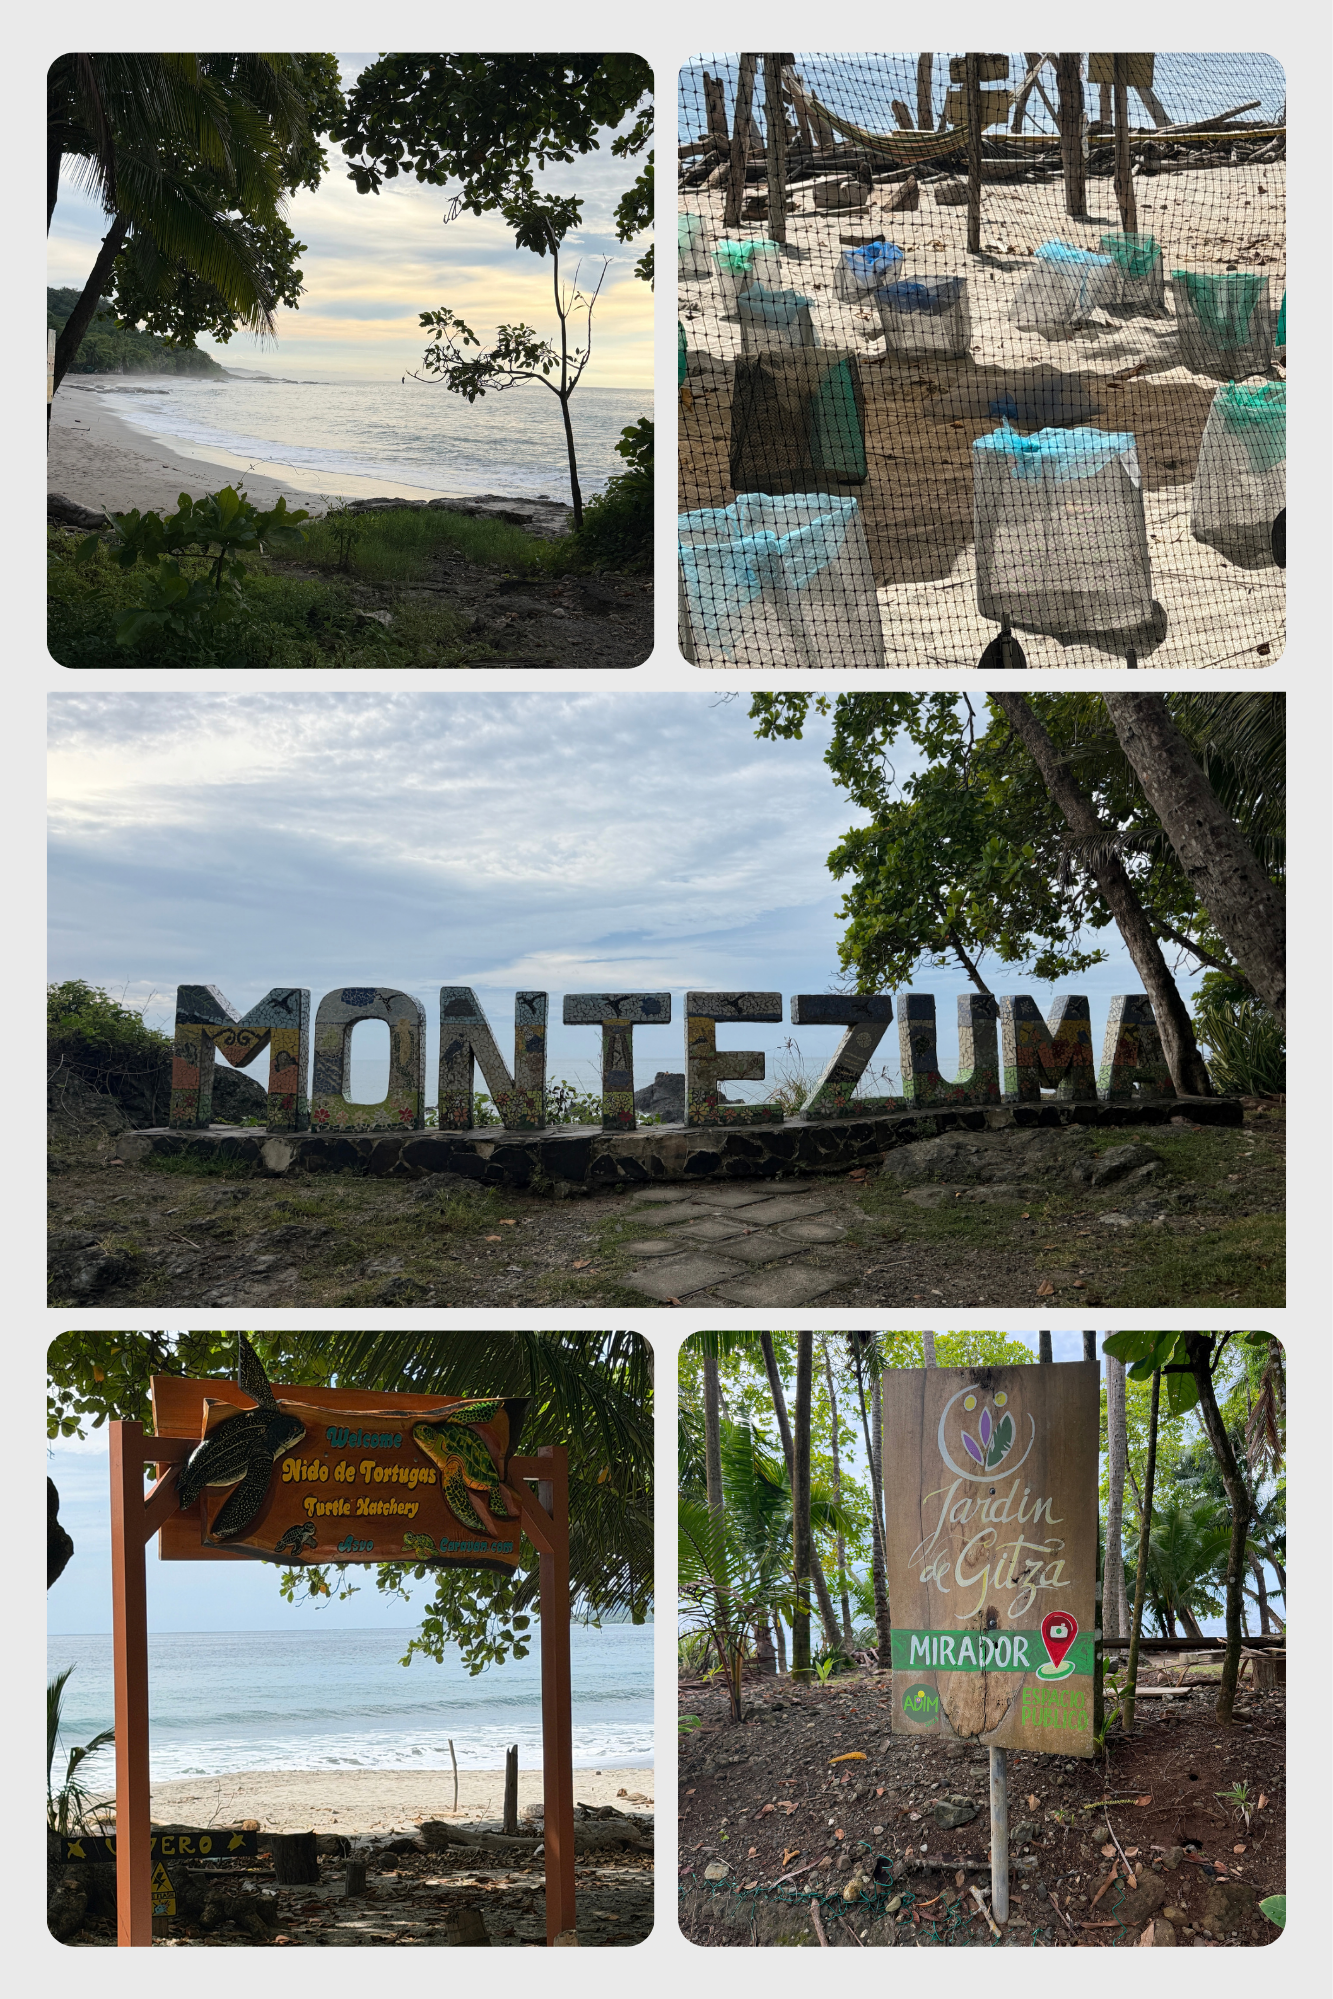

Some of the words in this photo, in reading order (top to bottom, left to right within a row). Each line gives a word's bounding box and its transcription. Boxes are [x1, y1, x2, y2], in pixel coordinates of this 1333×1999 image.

[169, 984, 1177, 1133] MONTEZUMA
[326, 1426, 403, 1448] Welcome
[281, 1457, 329, 1483] Nido
[333, 1460, 356, 1483] de
[359, 1459, 437, 1490] Tortugas
[303, 1496, 351, 1518] Turtle
[355, 1497, 420, 1519] Hatchery
[919, 1549, 951, 1593] de
[954, 1527, 1071, 1620] Gitza
[909, 1634, 1030, 1668] MIRADOR
[903, 1694, 939, 1713] ADIM
[1022, 1687, 1085, 1709] ESPACIO
[1021, 1706, 1089, 1731] PUBLICO
